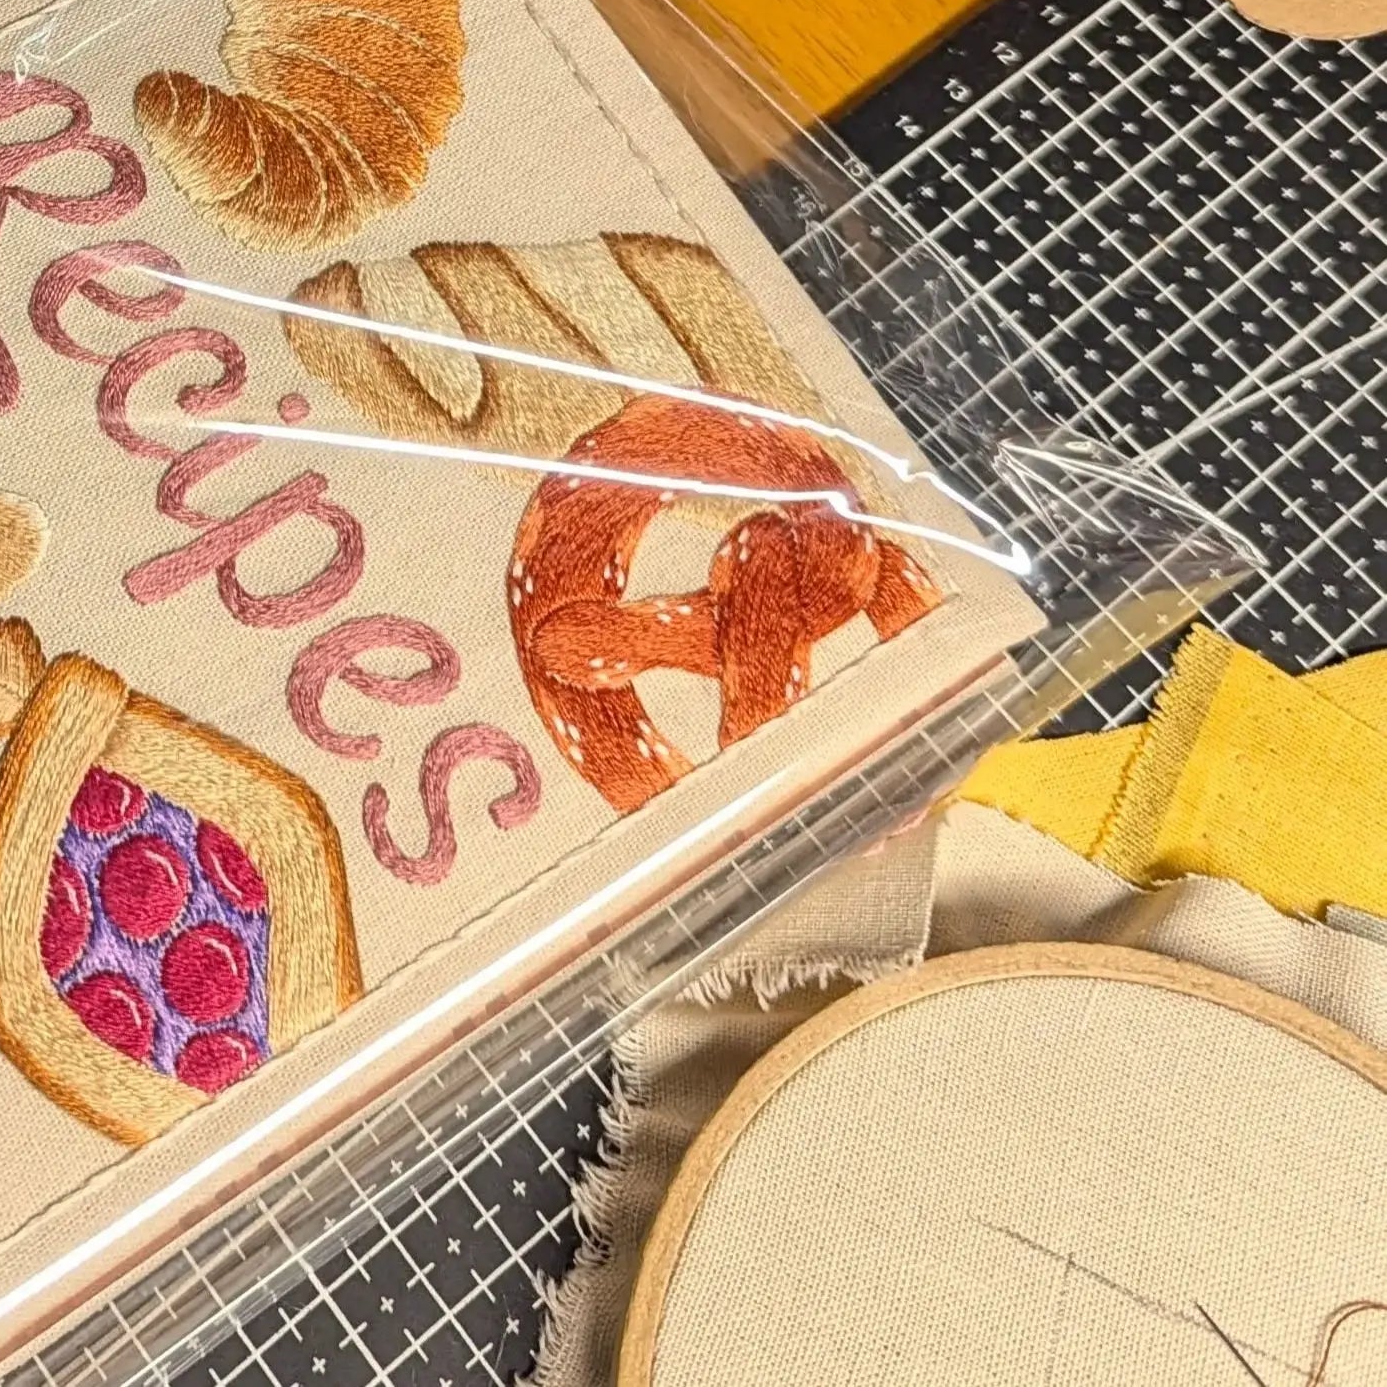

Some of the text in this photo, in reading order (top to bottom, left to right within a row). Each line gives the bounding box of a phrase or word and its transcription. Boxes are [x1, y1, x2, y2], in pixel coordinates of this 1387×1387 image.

[1040, 4, 1067, 26] 11
[991, 41, 1022, 66] 12
[943, 77, 971, 103] 13
[894, 114, 923, 139] 14
